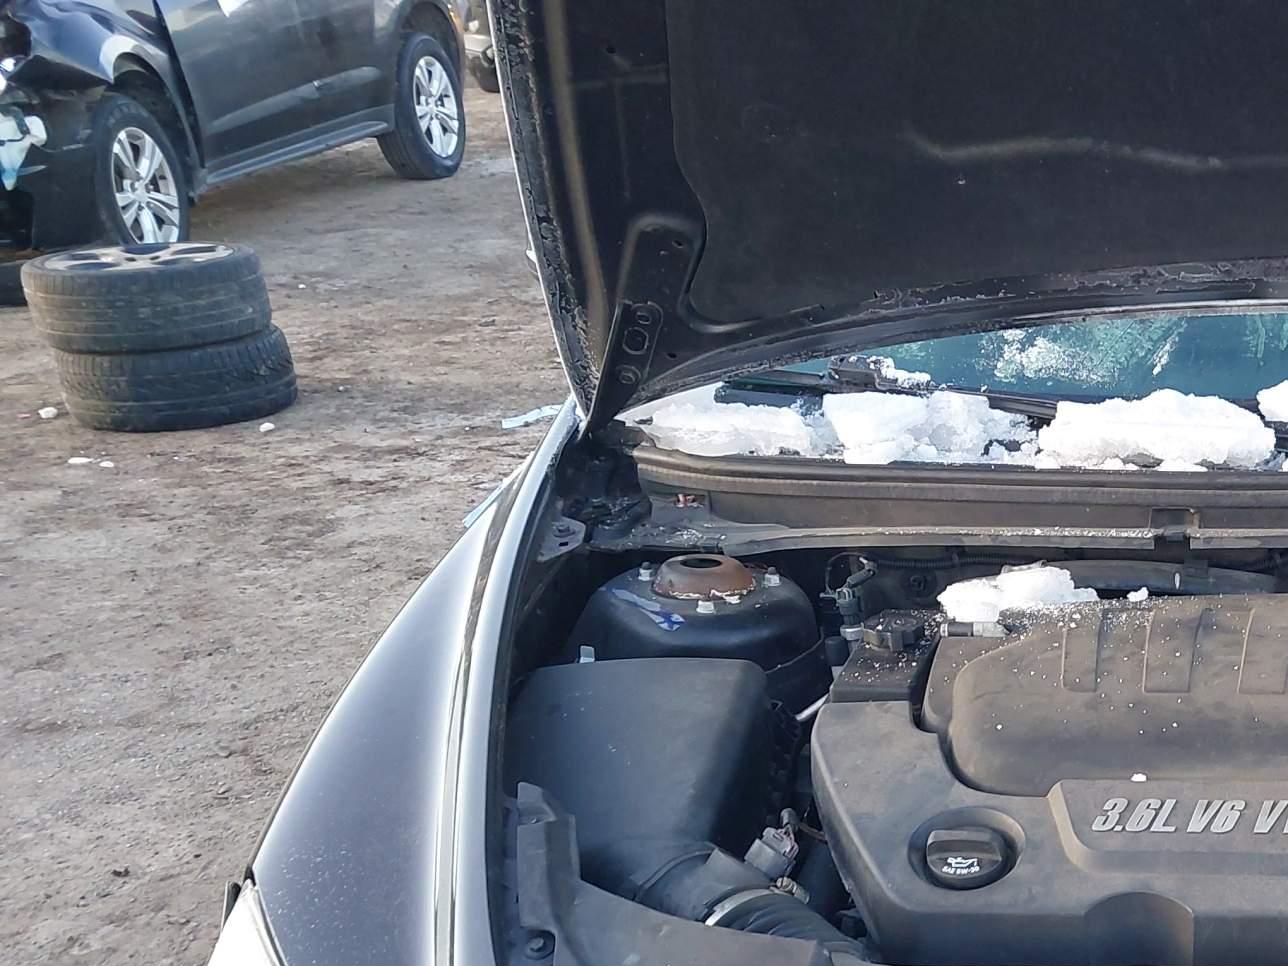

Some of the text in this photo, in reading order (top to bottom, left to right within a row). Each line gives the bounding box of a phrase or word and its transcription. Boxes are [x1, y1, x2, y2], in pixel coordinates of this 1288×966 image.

[1091, 797, 1177, 833] 3.6L
[1186, 799, 1246, 834] V6
[942, 865, 956, 873] SAE
